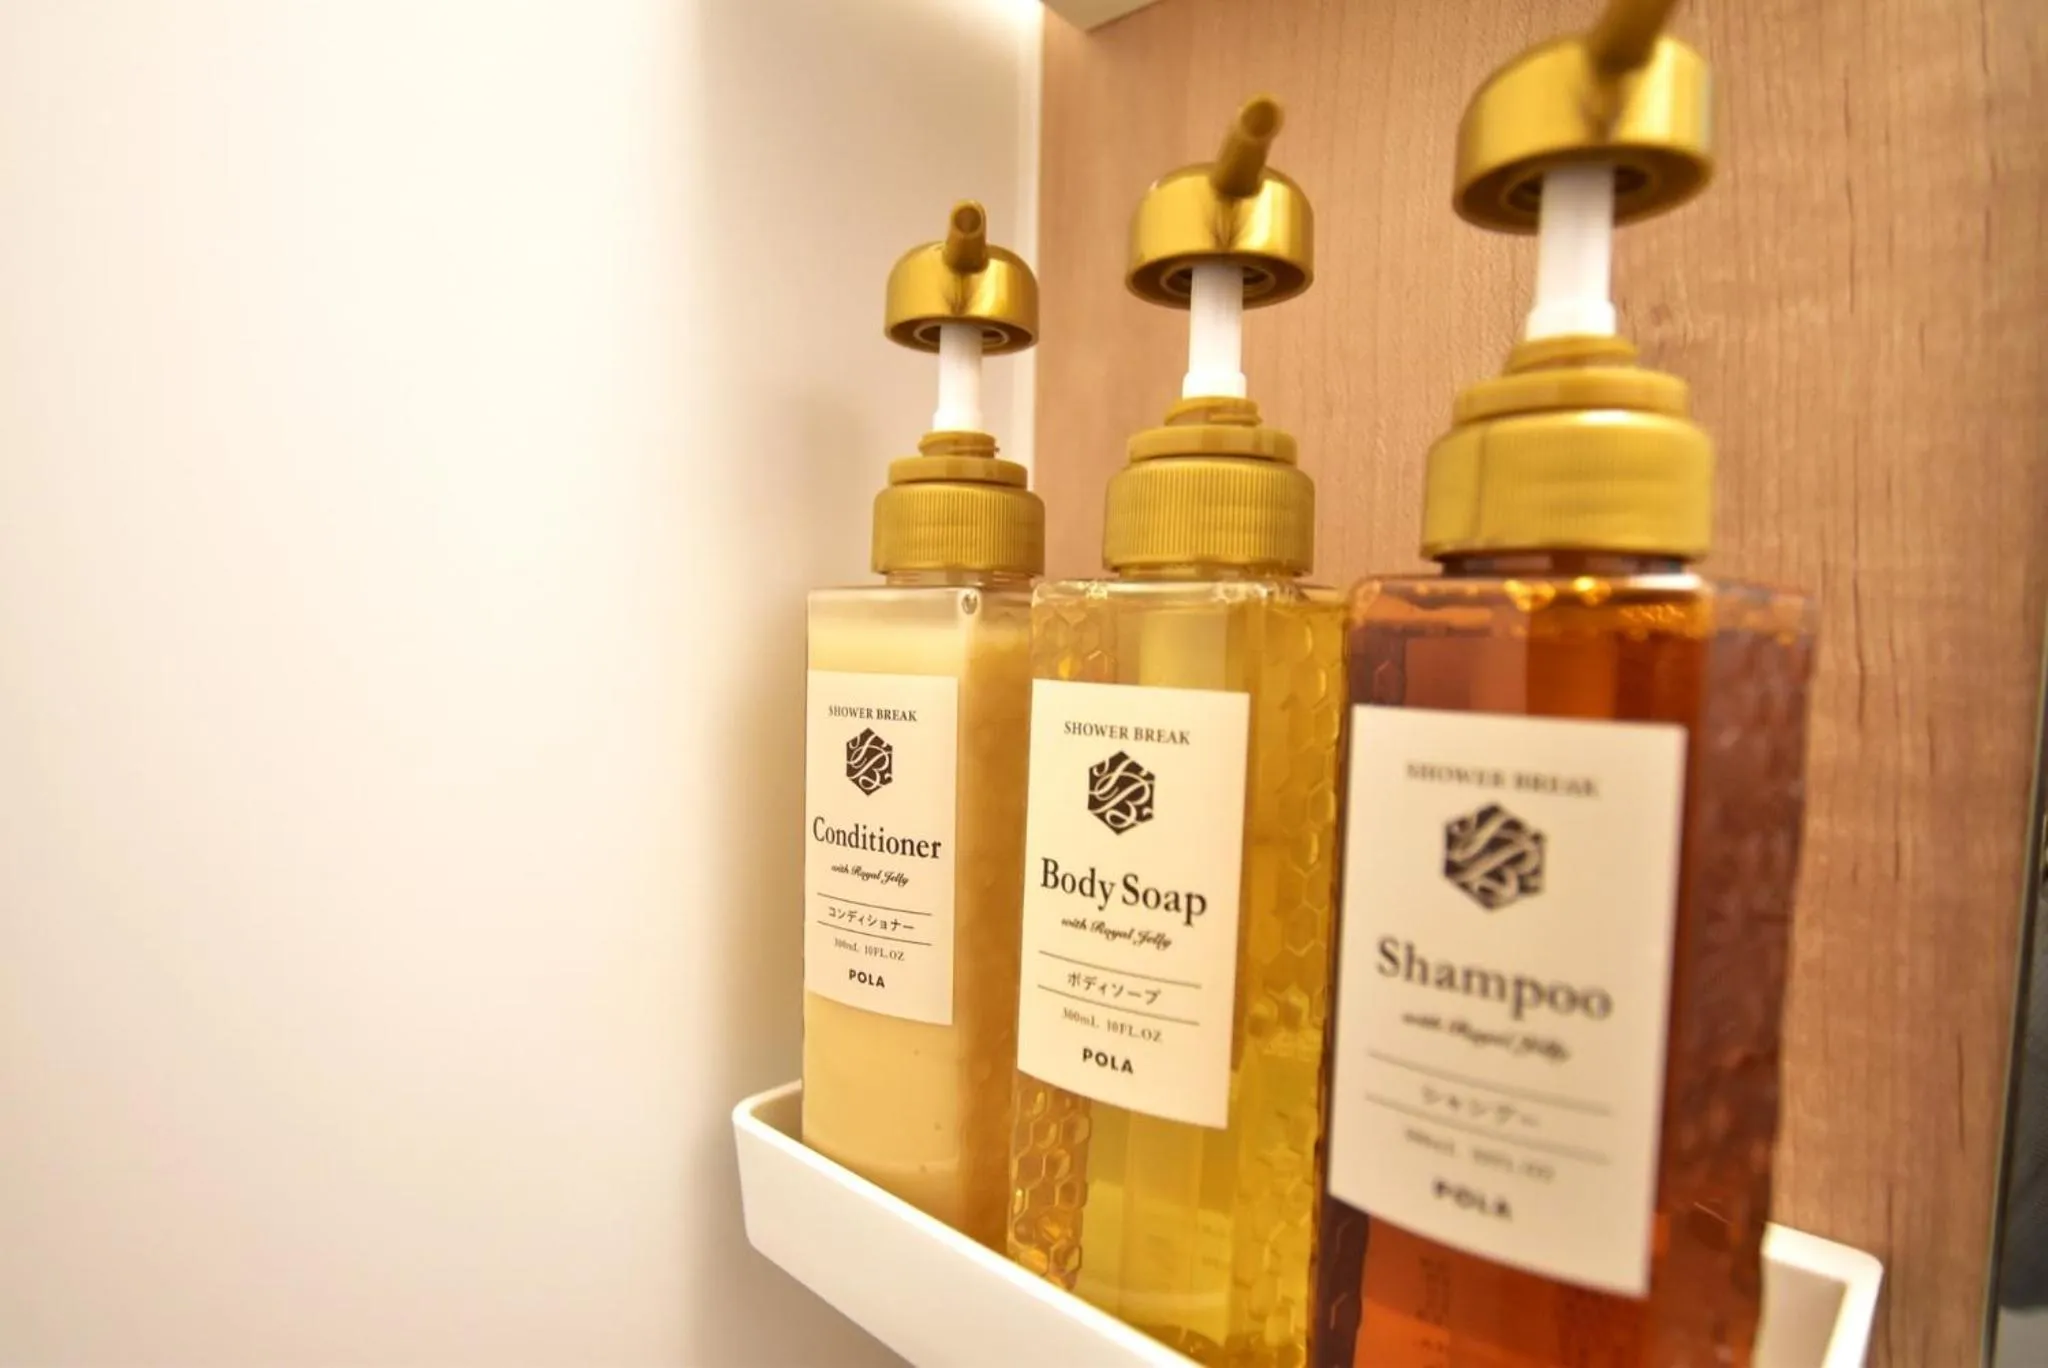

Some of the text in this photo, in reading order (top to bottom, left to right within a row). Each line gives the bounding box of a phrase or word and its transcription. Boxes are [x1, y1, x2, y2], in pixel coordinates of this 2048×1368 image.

[828, 705, 917, 722] SHOWER BREAK
[1064, 721, 1190, 745] SHOWER BREAK
[1406, 762, 1505, 788] SHOWER
[813, 816, 942, 859] Conditioner
[831, 864, 910, 887] with Royal Jelly
[1041, 857, 1207, 927] Body Soap
[828, 906, 915, 932] コンディショナー
[1061, 917, 1172, 950] with Royal Jelly
[849, 969, 885, 988] POLA
[1067, 971, 1161, 1005] ボディソープ
[1376, 935, 1616, 1021] Shampoo
[1082, 1047, 1134, 1074] POLA
